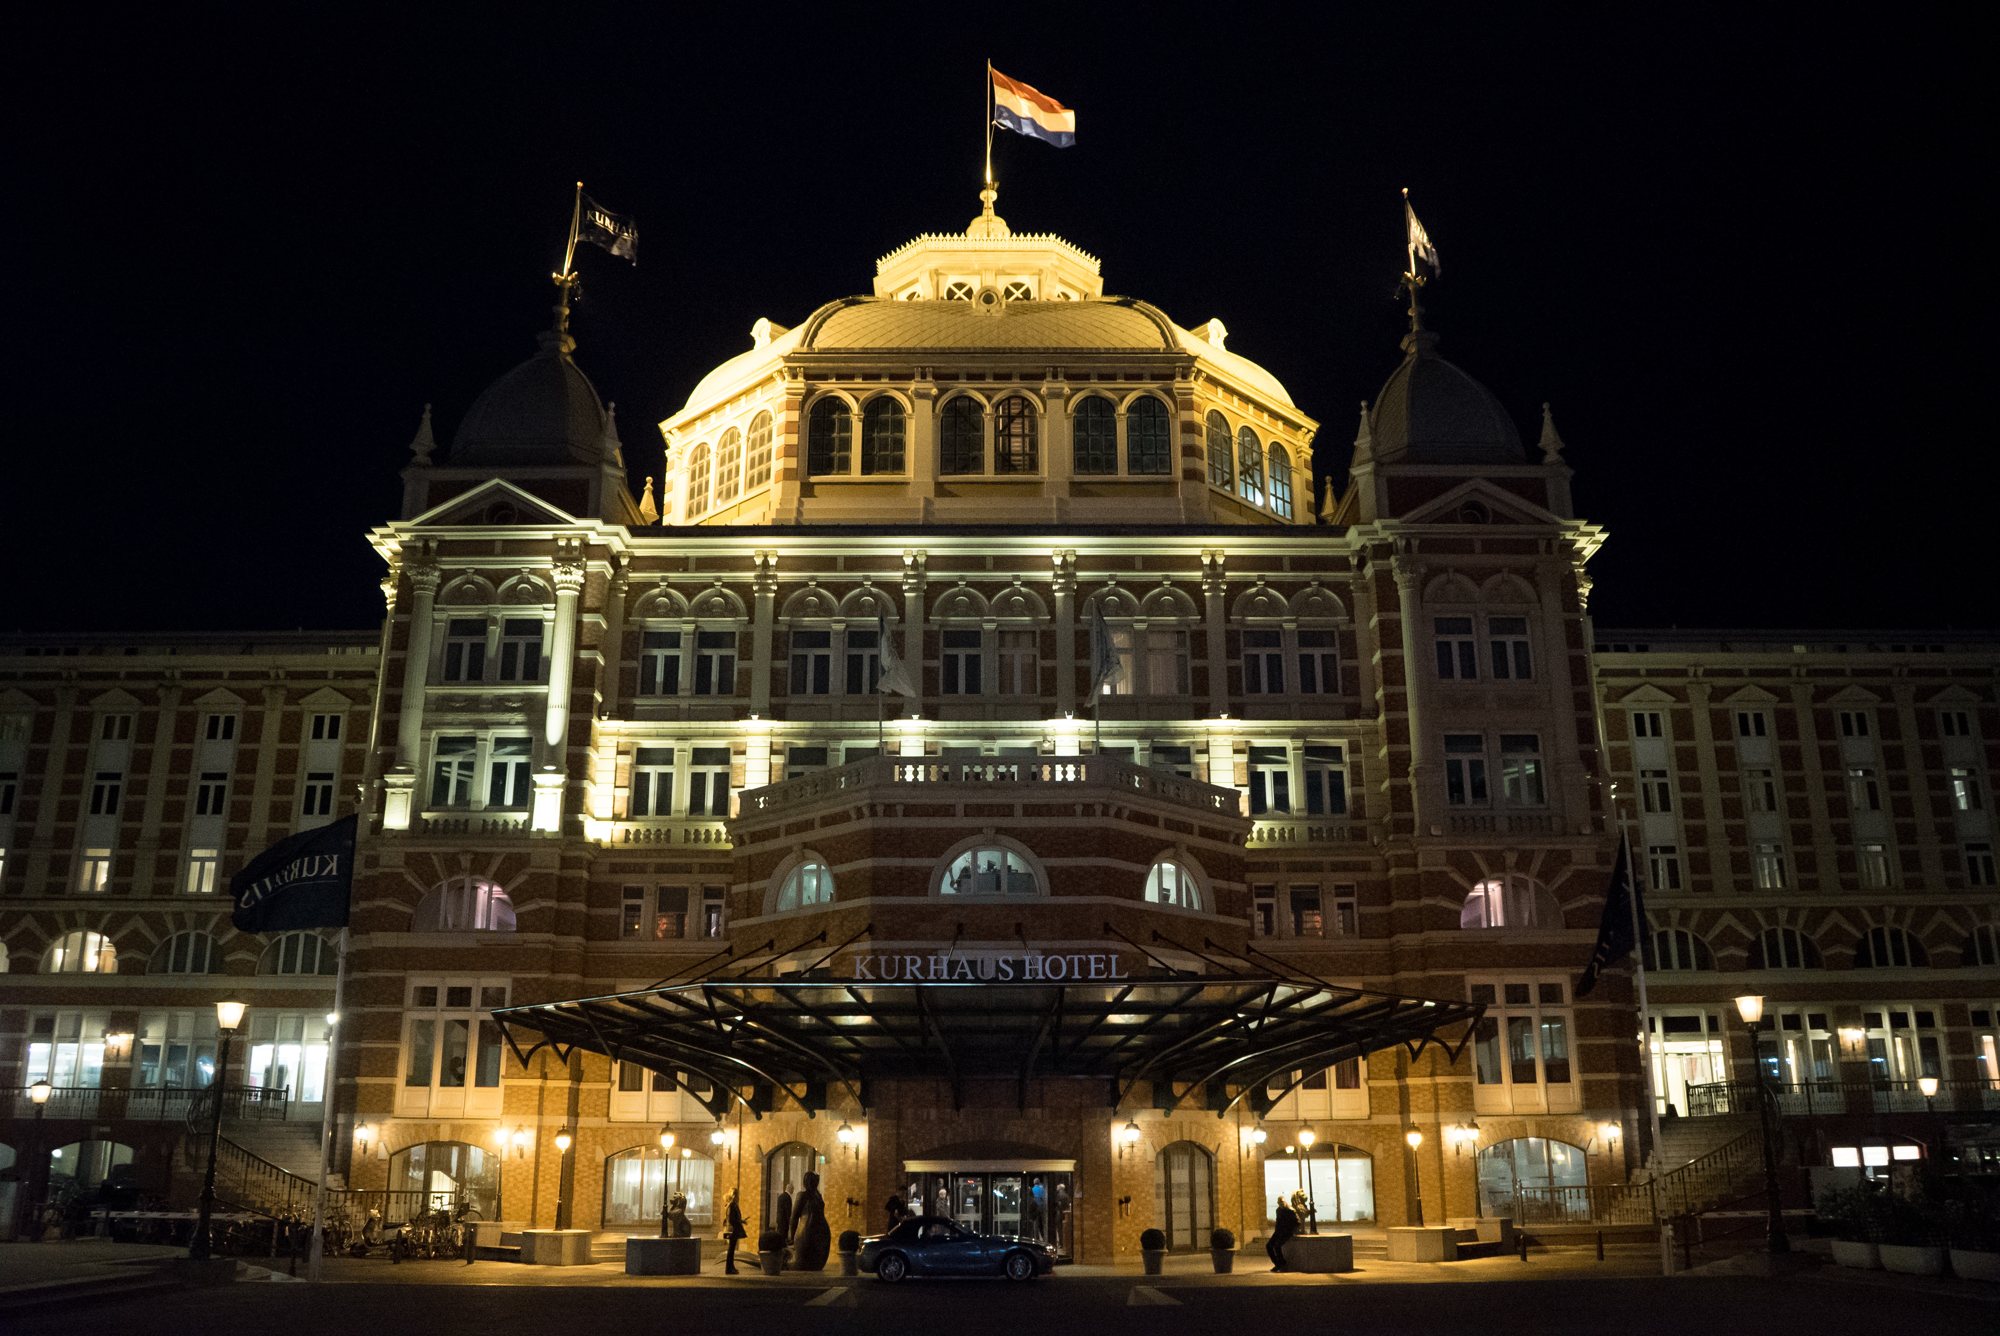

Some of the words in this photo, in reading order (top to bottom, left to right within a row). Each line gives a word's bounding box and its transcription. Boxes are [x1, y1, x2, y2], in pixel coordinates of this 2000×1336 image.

[586, 210, 639, 240] KURHA
[854, 954, 1013, 981] KURHAUS
[1023, 954, 1128, 980] HOTEL
